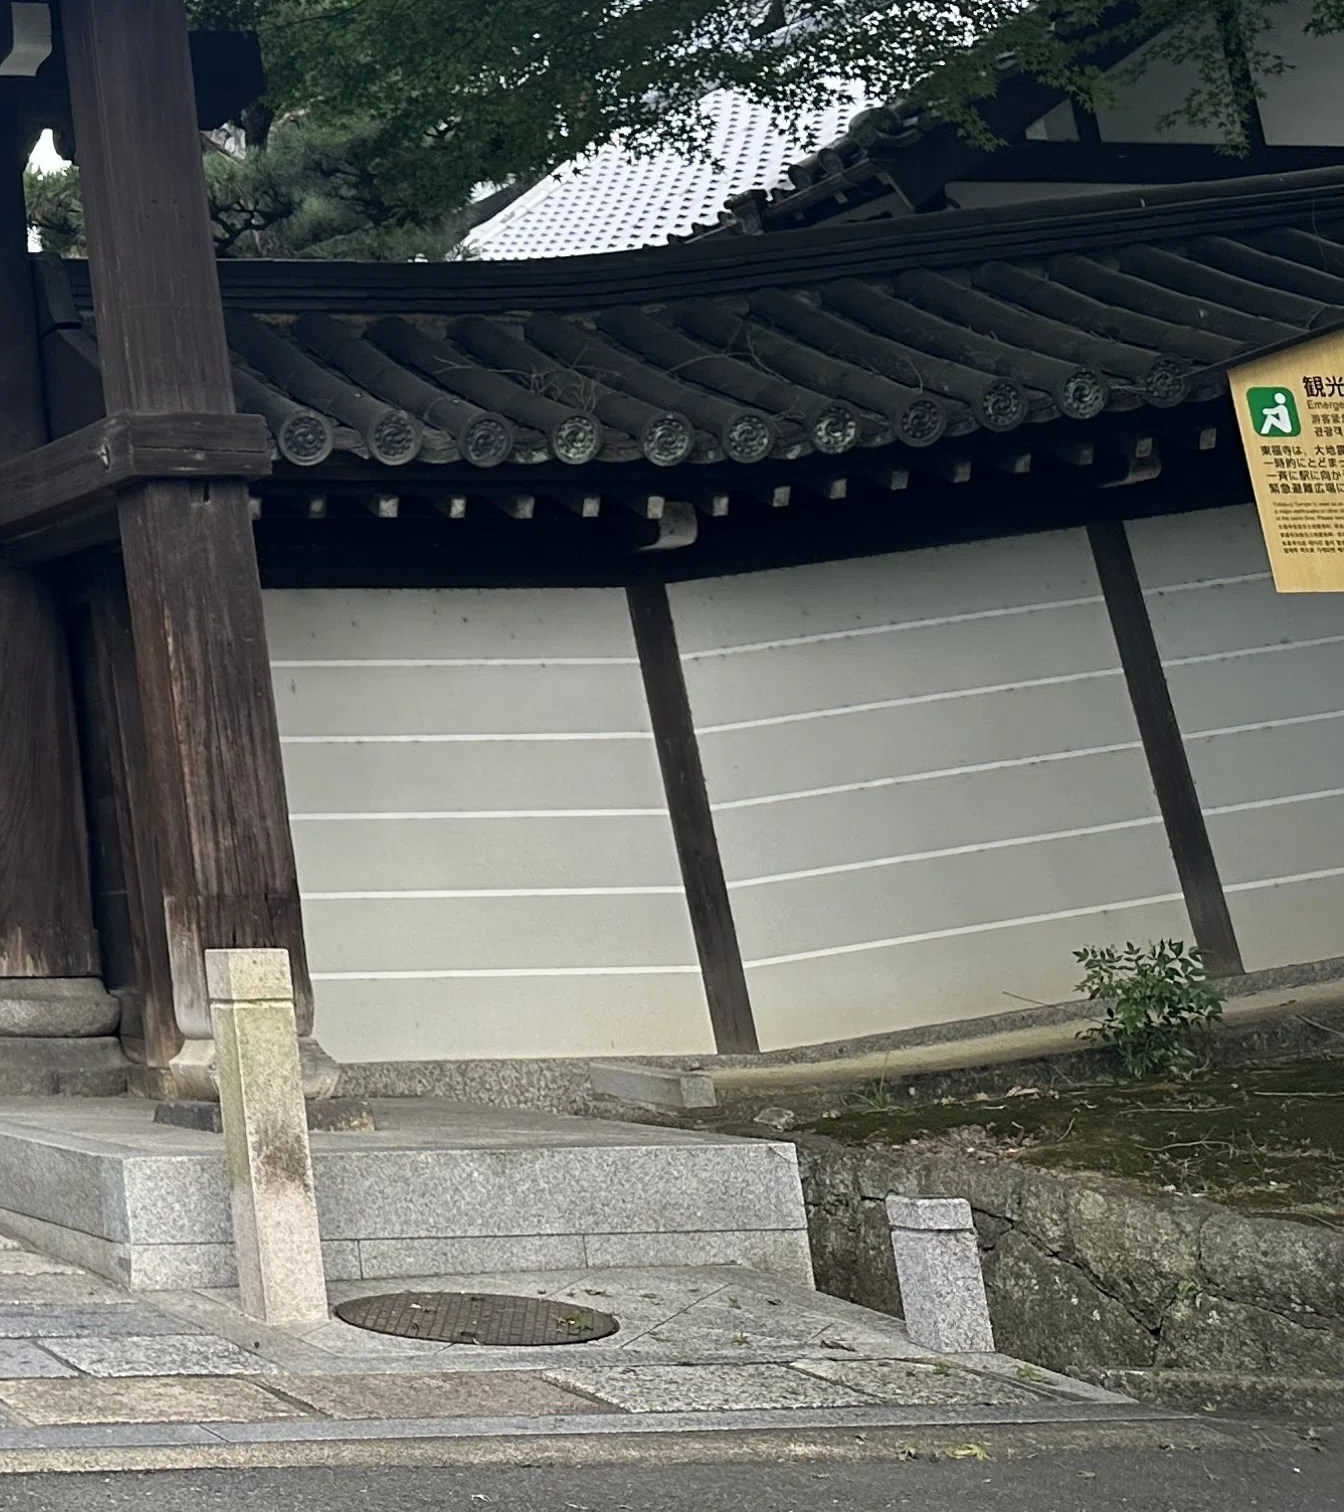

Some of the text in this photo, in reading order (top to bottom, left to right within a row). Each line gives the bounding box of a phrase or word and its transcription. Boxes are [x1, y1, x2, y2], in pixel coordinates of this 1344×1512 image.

[1303, 375, 1344, 397] 観光
[1266, 470, 1344, 481] 一斉に駅に向か
